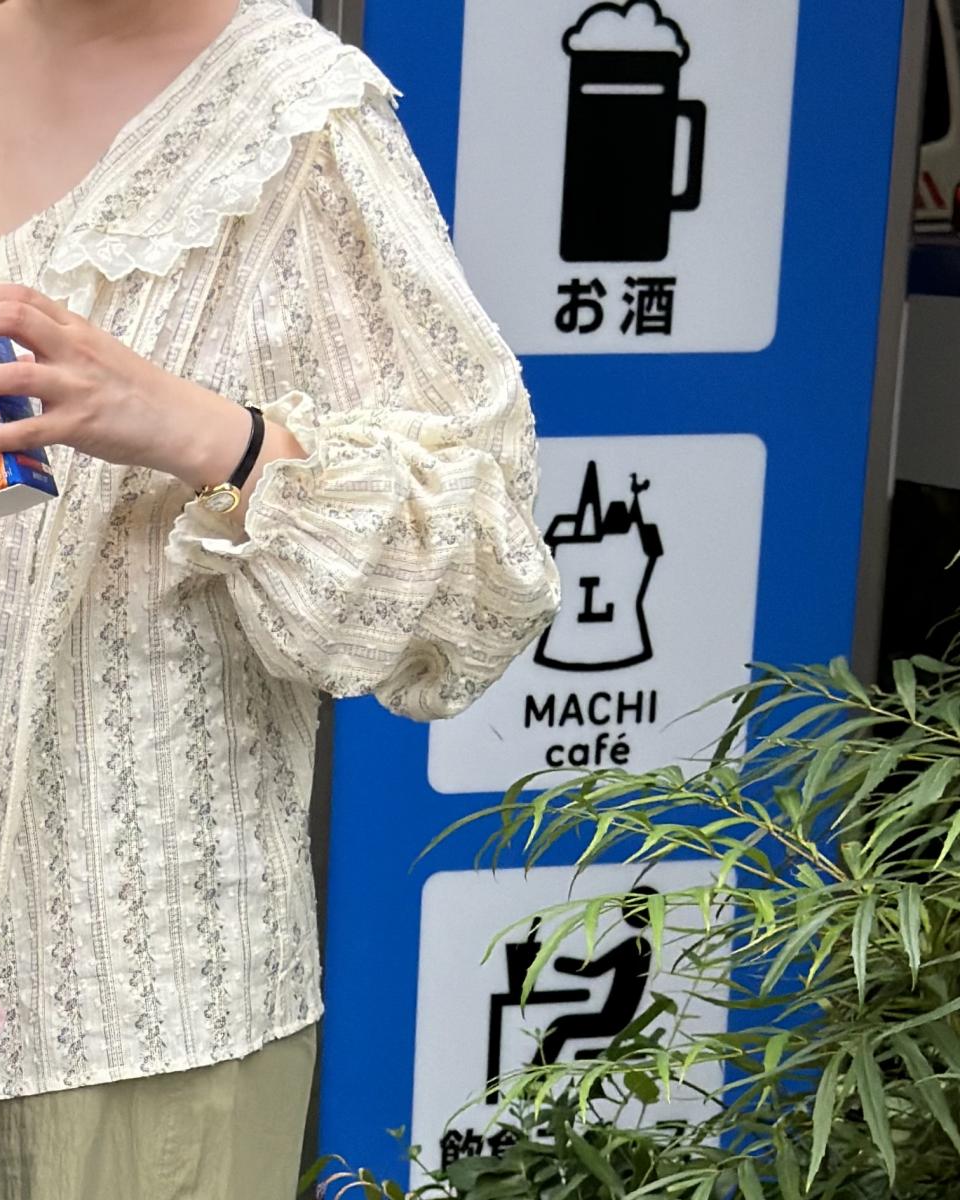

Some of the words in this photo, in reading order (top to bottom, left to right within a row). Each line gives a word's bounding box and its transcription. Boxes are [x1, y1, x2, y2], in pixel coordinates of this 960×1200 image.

[554, 276, 677, 336] お酒
[577, 576, 615, 623] L
[524, 690, 657, 728] MACHI
[545, 732, 630, 768] café
